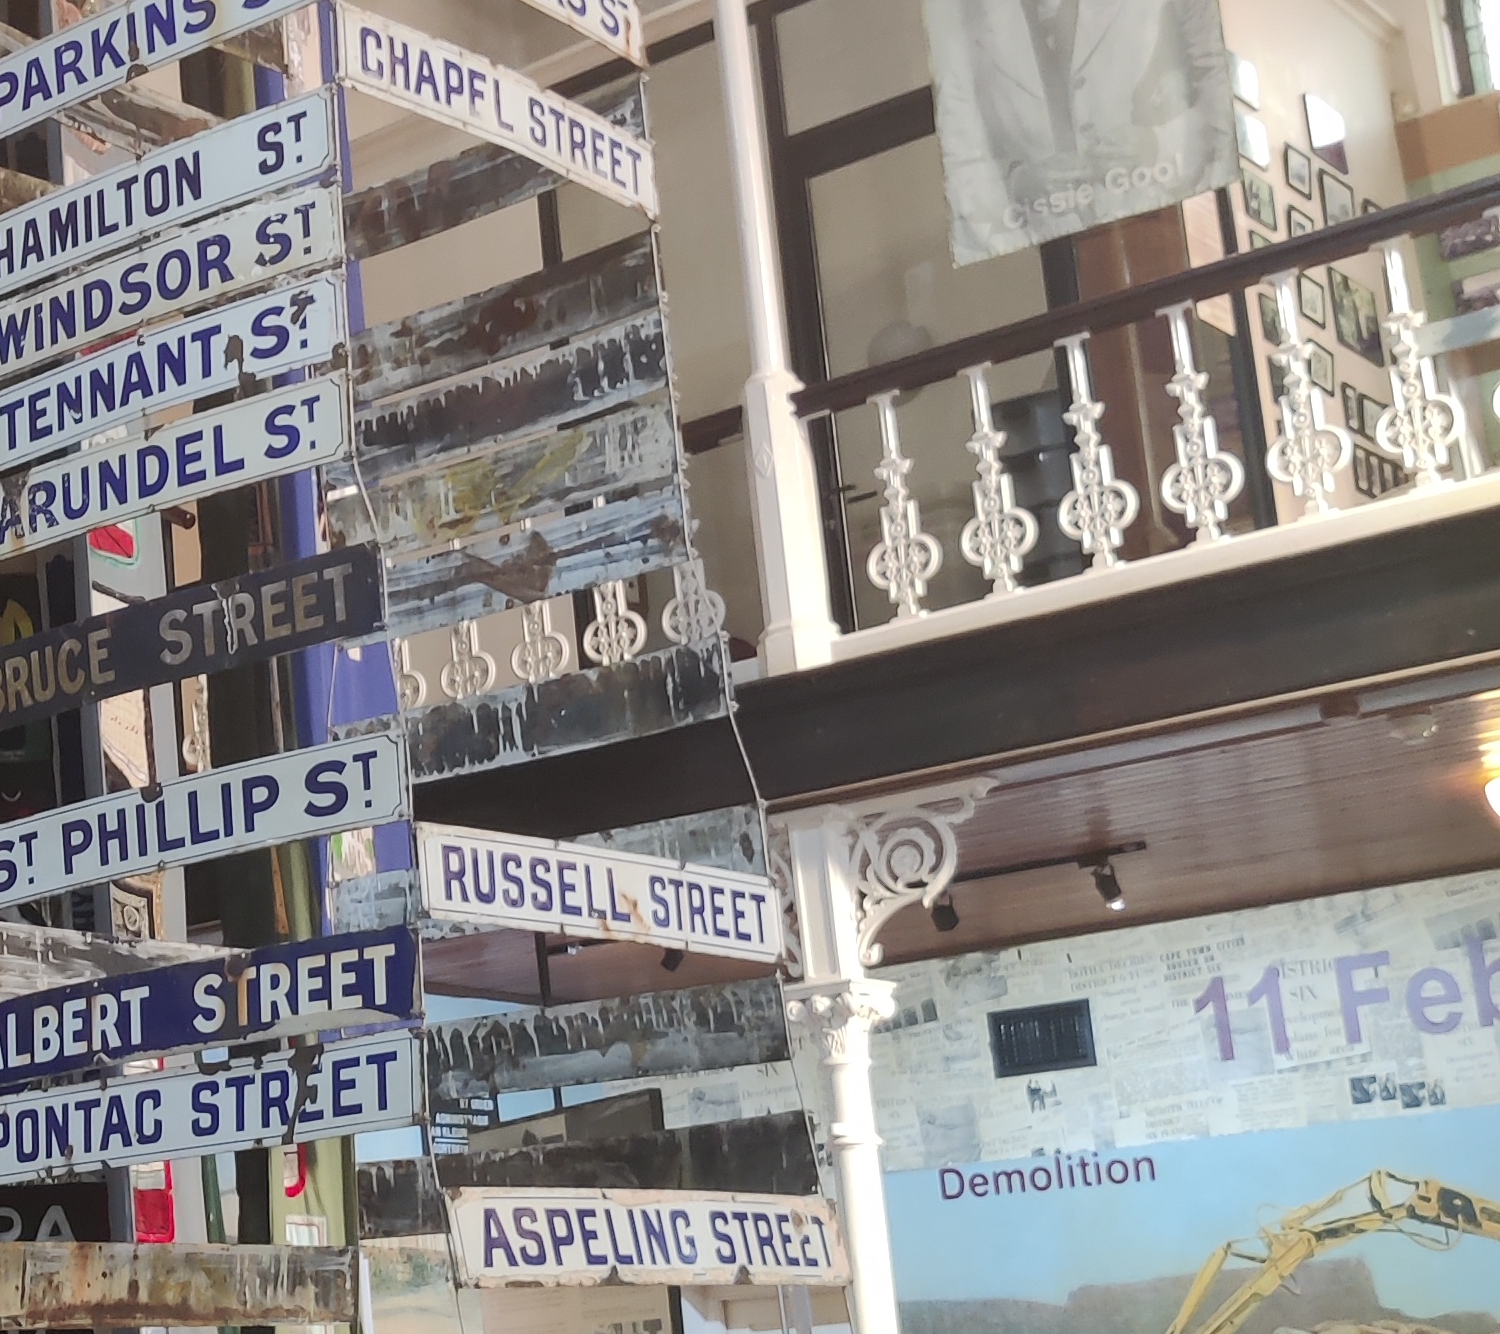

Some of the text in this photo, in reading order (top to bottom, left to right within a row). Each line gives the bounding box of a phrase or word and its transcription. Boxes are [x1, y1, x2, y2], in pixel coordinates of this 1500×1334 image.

[528, 96, 642, 196] STREET
[0, 324, 222, 450] TENNANT
[159, 563, 353, 666] STREET
[61, 774, 280, 875] PHILLIP
[441, 844, 767, 945] RUSSELL STREET
[192, 943, 396, 1036] STREET
[1194, 964, 1291, 1061] 11
[191, 1050, 399, 1137] STREET
[939, 1150, 1157, 1202] Demolition
[482, 1207, 833, 1269] ASPELING STREET
